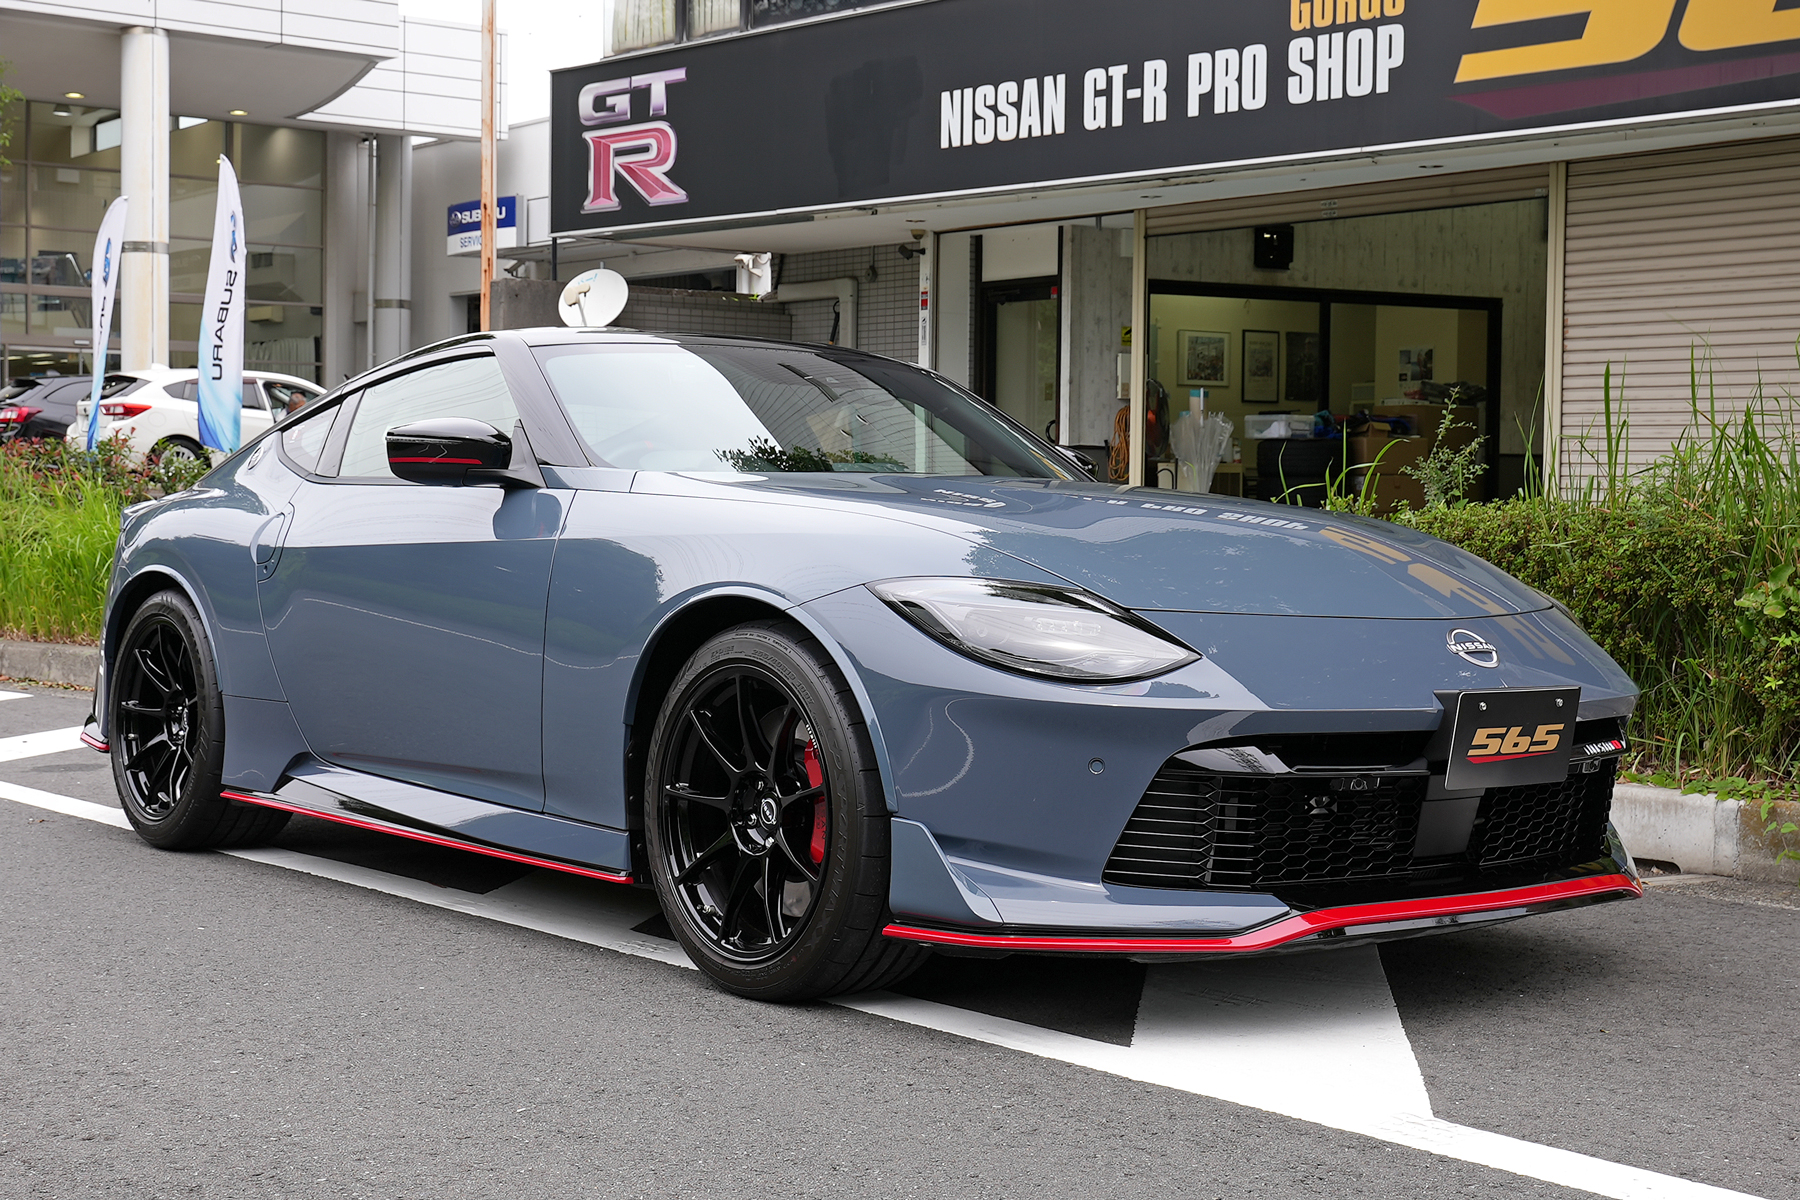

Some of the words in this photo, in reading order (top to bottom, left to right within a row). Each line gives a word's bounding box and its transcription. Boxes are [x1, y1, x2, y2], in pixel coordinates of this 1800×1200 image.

[578, 67, 687, 126] GT
[940, 74, 1066, 149] NISSAN
[1083, 59, 1168, 131] GT-R
[1187, 43, 1268, 118] PRO
[1287, 23, 1405, 104] SHOP
[580, 120, 689, 214] R
[461, 206, 506, 224] SUBU
[1451, 642, 1496, 651] NISSAN
[1467, 723, 1565, 756] 565
